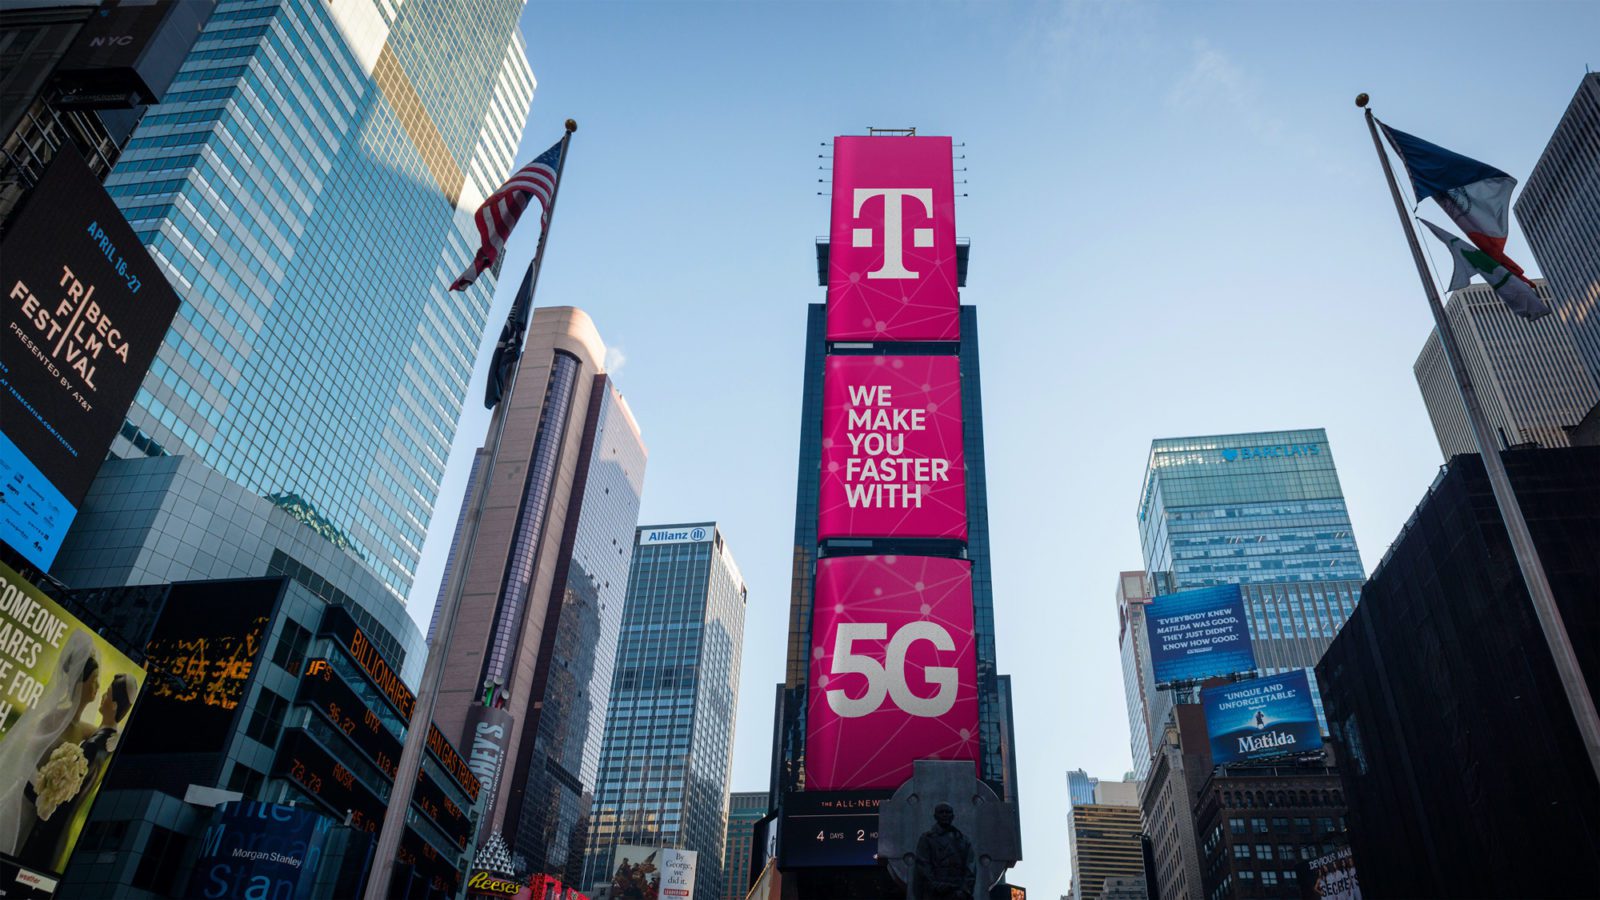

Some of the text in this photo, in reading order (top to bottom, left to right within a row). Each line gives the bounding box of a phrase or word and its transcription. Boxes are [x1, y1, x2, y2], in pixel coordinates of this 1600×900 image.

[90, 36, 133, 47] NYC
[88, 221, 113, 262] APRIL
[10, 322, 93, 412] PRESENTED BY AT&T
[848, 386, 892, 407] WE
[848, 409, 926, 431] MAKE
[847, 433, 904, 456] YOU
[1241, 443, 1320, 460] BARCLAYS
[846, 458, 949, 482] FASTER
[845, 484, 922, 508] WITH
[648, 531, 688, 541] Allianz
[1207, 608, 1232, 618] KNEW
[1157, 624, 1191, 634] MATILDA
[1192, 620, 1211, 629] WAS
[1162, 626, 1233, 642] THEY JUST DIDN'T
[0, 617, 42, 669] ARES
[1163, 641, 1188, 651] KNOW
[1190, 638, 1211, 647] HOW
[826, 621, 959, 718] 5G
[8, 671, 44, 710] FOR
[1263, 683, 1283, 693] AND
[350, 628, 412, 716] BILLIONAIRE
[441, 743, 458, 774] GAS
[1238, 731, 1296, 754] Matilda
[836, 799, 880, 808] ALL-NEW
[816, 830, 825, 842] 4
[829, 832, 844, 840] DAYS
[857, 829, 865, 842] 2
[232, 847, 303, 869] Morgan Stanley
[665, 860, 693, 870] George,
[676, 852, 685, 862] By
[1309, 852, 1337, 870] DEVIOUS
[467, 871, 522, 894] Reese's
[668, 877, 679, 885] did
